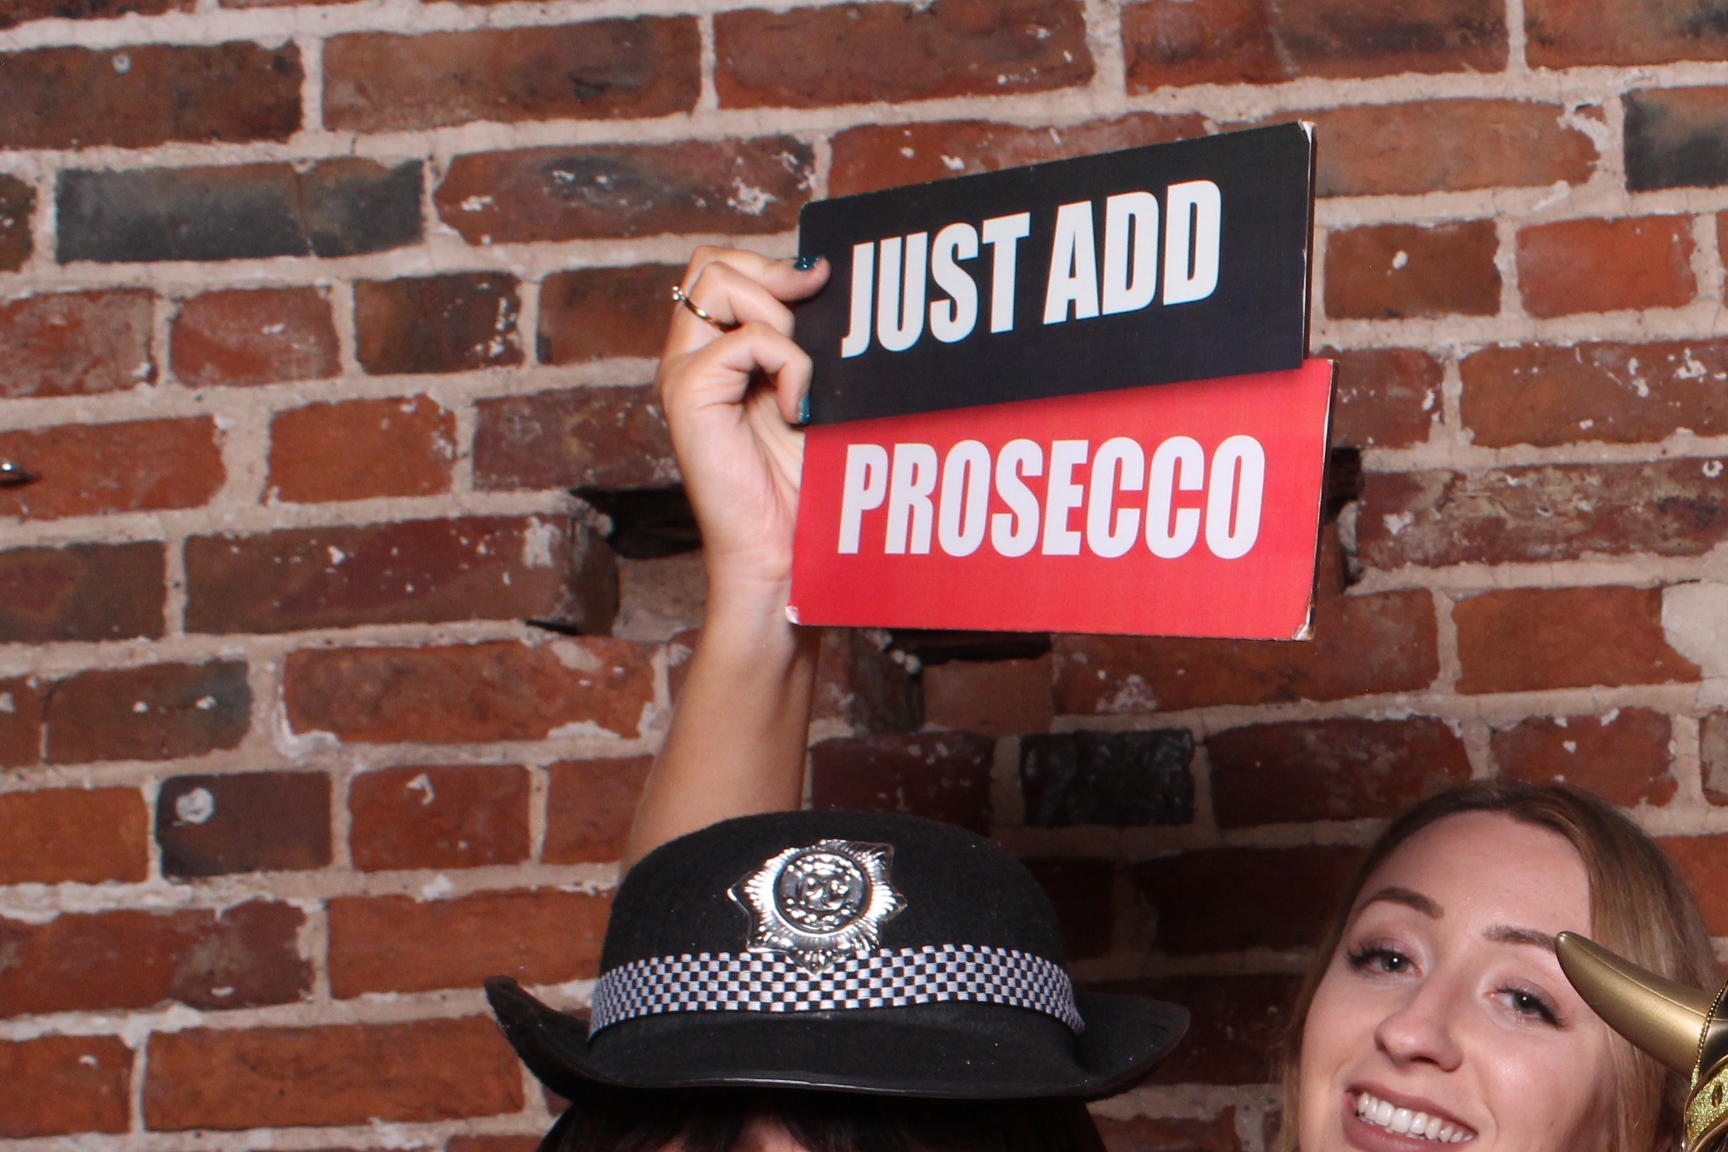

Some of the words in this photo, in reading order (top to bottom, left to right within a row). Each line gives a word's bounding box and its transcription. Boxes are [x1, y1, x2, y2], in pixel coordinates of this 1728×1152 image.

[841, 211, 1031, 358] JUST
[1042, 180, 1222, 324] ADD
[837, 435, 1267, 560] PROSECCO
